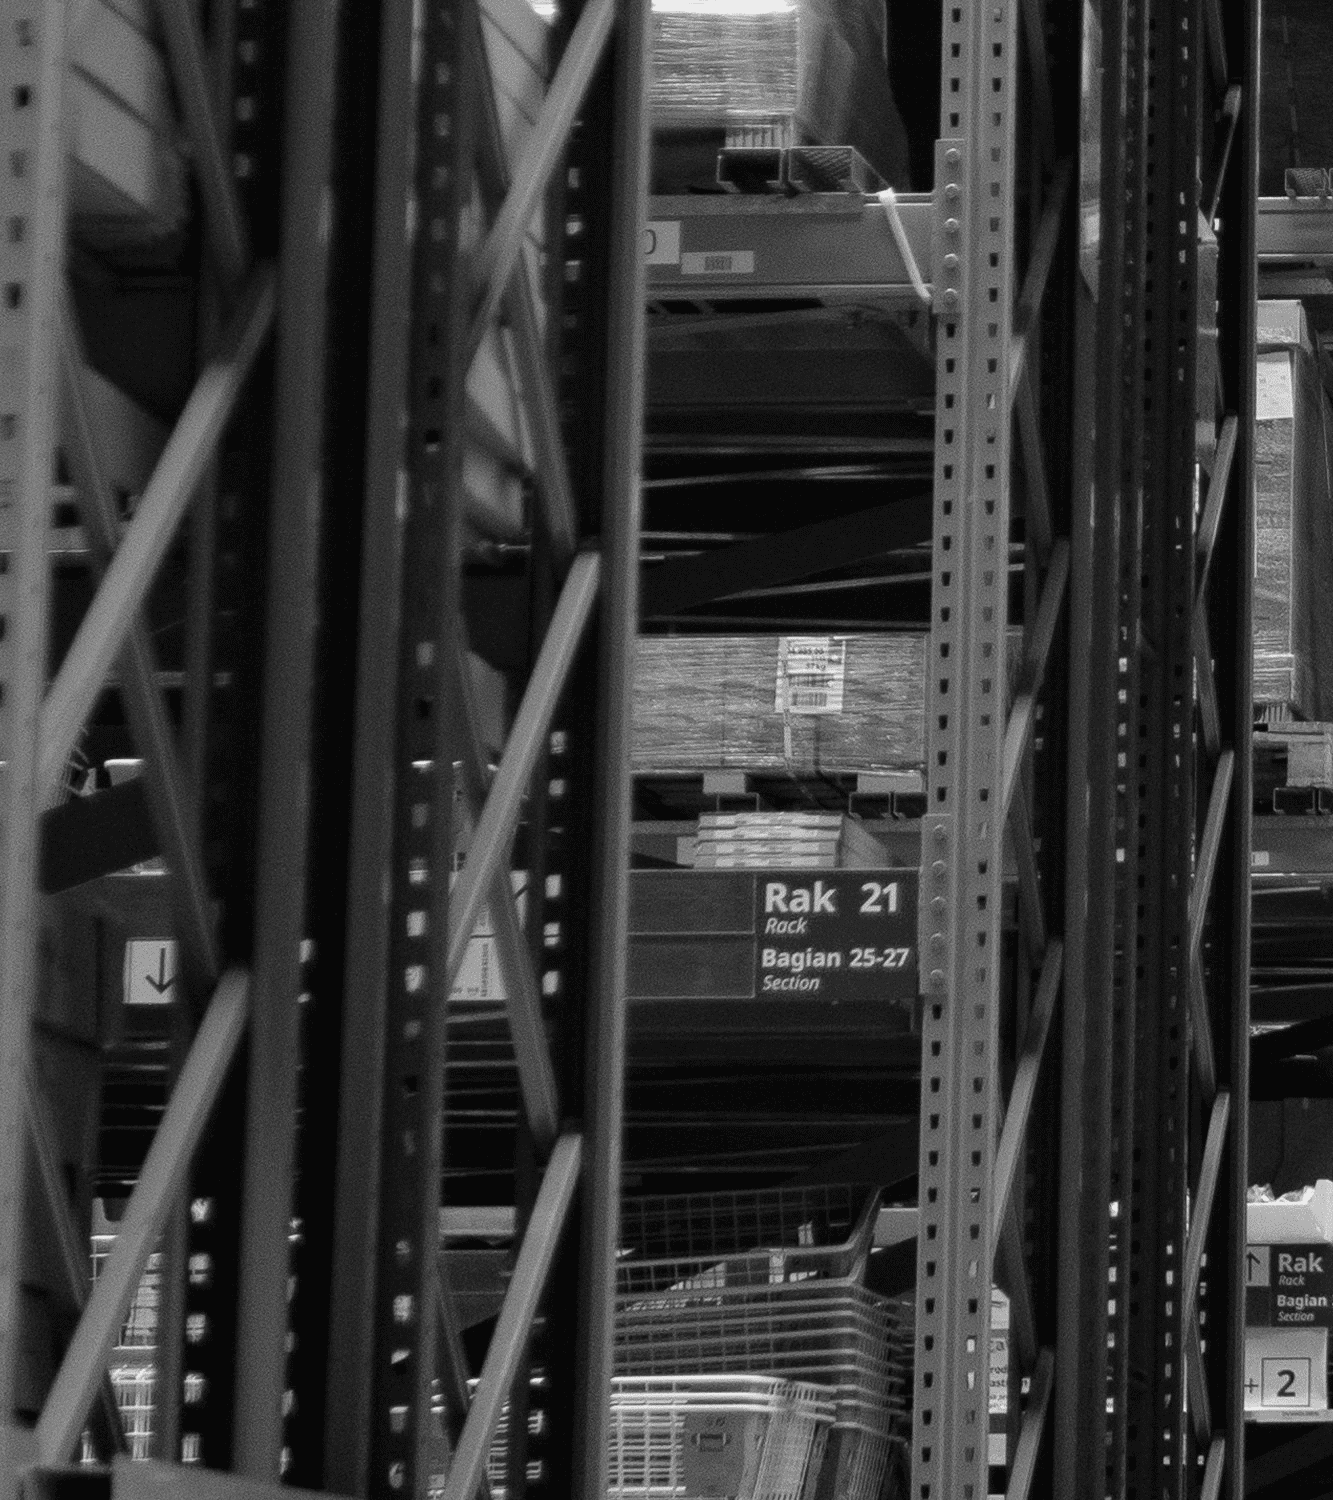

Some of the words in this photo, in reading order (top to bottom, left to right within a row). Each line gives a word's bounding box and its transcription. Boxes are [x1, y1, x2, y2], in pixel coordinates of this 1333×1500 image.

[766, 881, 837, 913] Rak
[859, 882, 898, 913] 21
[765, 916, 808, 934] Rack
[763, 948, 842, 972] Bagian
[849, 948, 910, 968] 25-27
[763, 974, 821, 991] Section
[1278, 1252, 1324, 1273] Rak
[1278, 1275, 1305, 1287] Rack
[1277, 1294, 1328, 1310] Bagian
[1277, 1310, 1316, 1323] Section
[1277, 1369, 1296, 1397] 2
